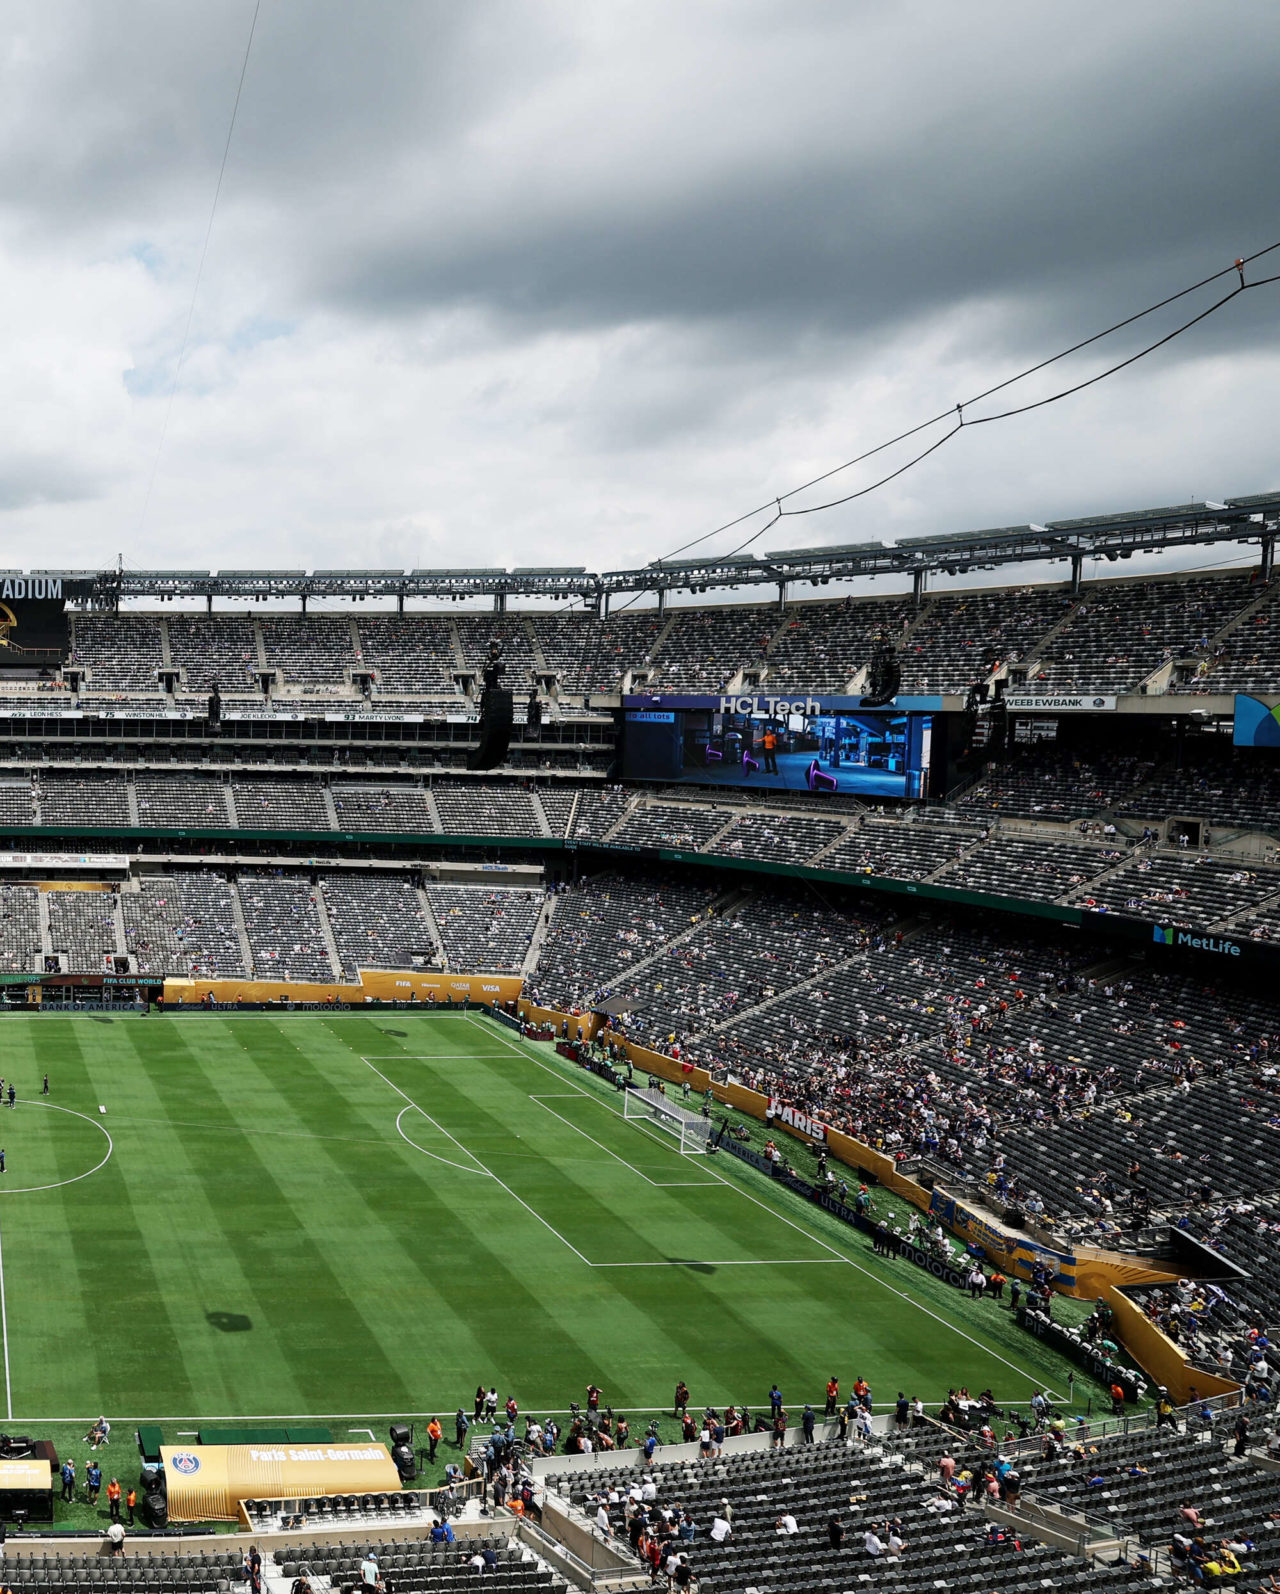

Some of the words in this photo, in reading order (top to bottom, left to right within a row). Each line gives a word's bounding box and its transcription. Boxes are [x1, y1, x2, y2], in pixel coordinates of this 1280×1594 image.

[721, 697, 820, 715] HCLTech
[1005, 699, 1033, 707] WEEB
[1035, 699, 1082, 707] EWBANK
[1177, 932, 1241, 956] MetLife
[481, 984, 500, 992] VISA
[41, 1003, 70, 1011] BANK
[72, 1003, 86, 1011] OF
[89, 1003, 136, 1011] AMERICA
[303, 1003, 351, 1011] motorola
[770, 1100, 824, 1140] PARIS
[726, 1140, 760, 1166] AMERICA
[821, 1195, 855, 1222] ULTRA
[1025, 1317, 1045, 1335] PIF
[1094, 1362, 1114, 1382] PIF
[250, 1449, 287, 1462] Paris
[289, 1448, 385, 1462] Saint-Germain
